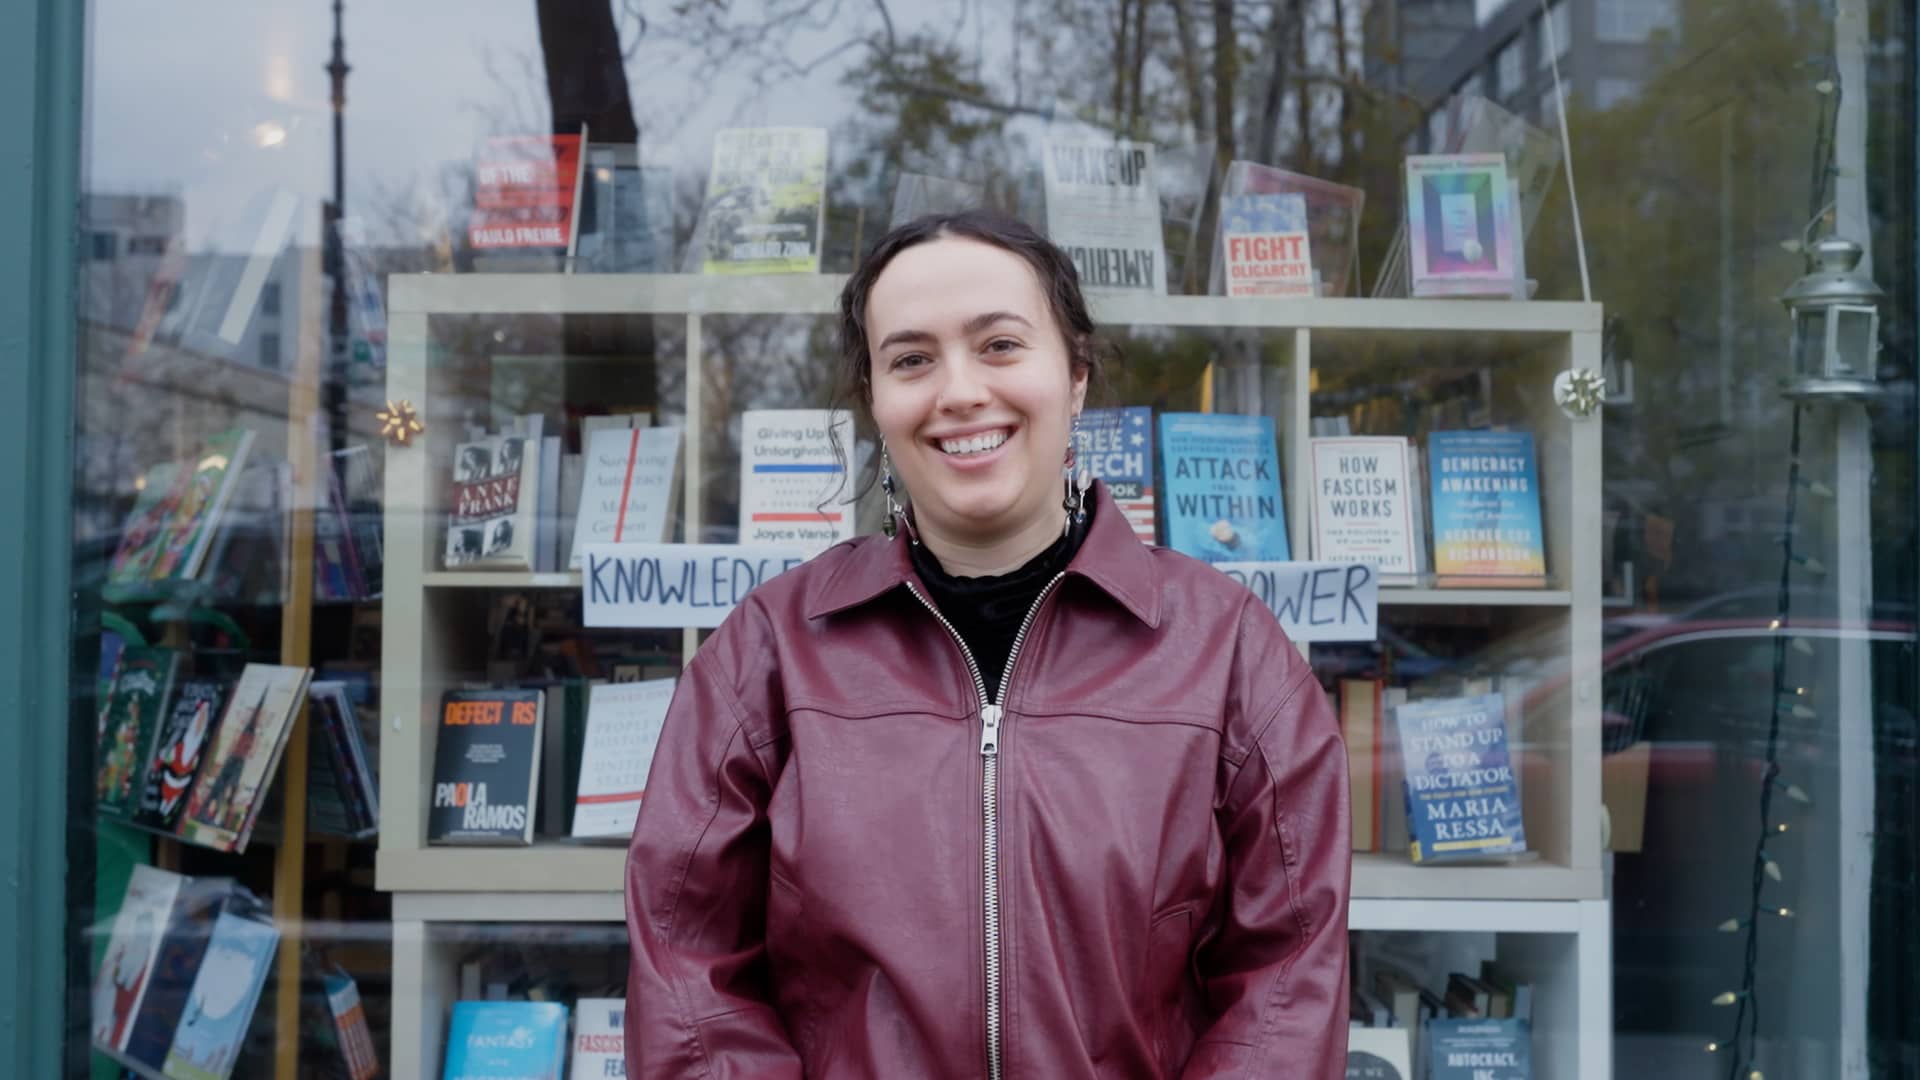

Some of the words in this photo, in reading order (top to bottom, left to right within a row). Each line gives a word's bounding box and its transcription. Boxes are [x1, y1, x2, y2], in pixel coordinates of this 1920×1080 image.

[1053, 146, 1116, 186] WAKE
[1119, 149, 1146, 187] UP
[473, 229, 515, 244] PAULO
[517, 226, 562, 243] FREIRE
[1230, 236, 1304, 262] FIGHT
[1062, 246, 1154, 288] AMERIC
[1232, 263, 1306, 279] OLIGARCHY
[758, 427, 803, 441] Giving
[806, 427, 825, 441] Up
[1077, 428, 1123, 453] REE
[598, 455, 668, 469] Surving
[753, 444, 843, 459] Unforgivab
[1076, 451, 1143, 477] EECH
[1175, 456, 1271, 480] ATTACK
[1339, 456, 1378, 474] HOW
[1441, 457, 1526, 473] DEMOCRACY
[461, 477, 518, 502] ANNE
[1323, 478, 1398, 497] FASCISM
[1441, 477, 1529, 494] AWAKENING
[458, 493, 516, 515] FRANK
[1175, 493, 1276, 520] WITHIN
[1330, 499, 1393, 518] WORKS
[753, 528, 796, 543] Joyce
[798, 528, 841, 541] Vance
[588, 551, 804, 607] KNOWLED
[445, 702, 504, 725] DEFECT
[1421, 717, 1459, 731] HOW
[1463, 712, 1487, 727] TO
[1411, 732, 1474, 753] STAND
[1477, 727, 1503, 745] UP
[1441, 753, 1466, 768] TO
[1468, 751, 1481, 766] A
[1414, 766, 1512, 791] DICTATOR
[434, 782, 488, 807] PAOLA
[463, 804, 526, 830] RAMOS
[1427, 796, 1508, 821] MARIA
[1434, 819, 1505, 841] RESSA
[467, 1034, 536, 1049] FANTASY
[577, 1035, 624, 1053] FASCIS
[604, 1058, 625, 1077] FEA
